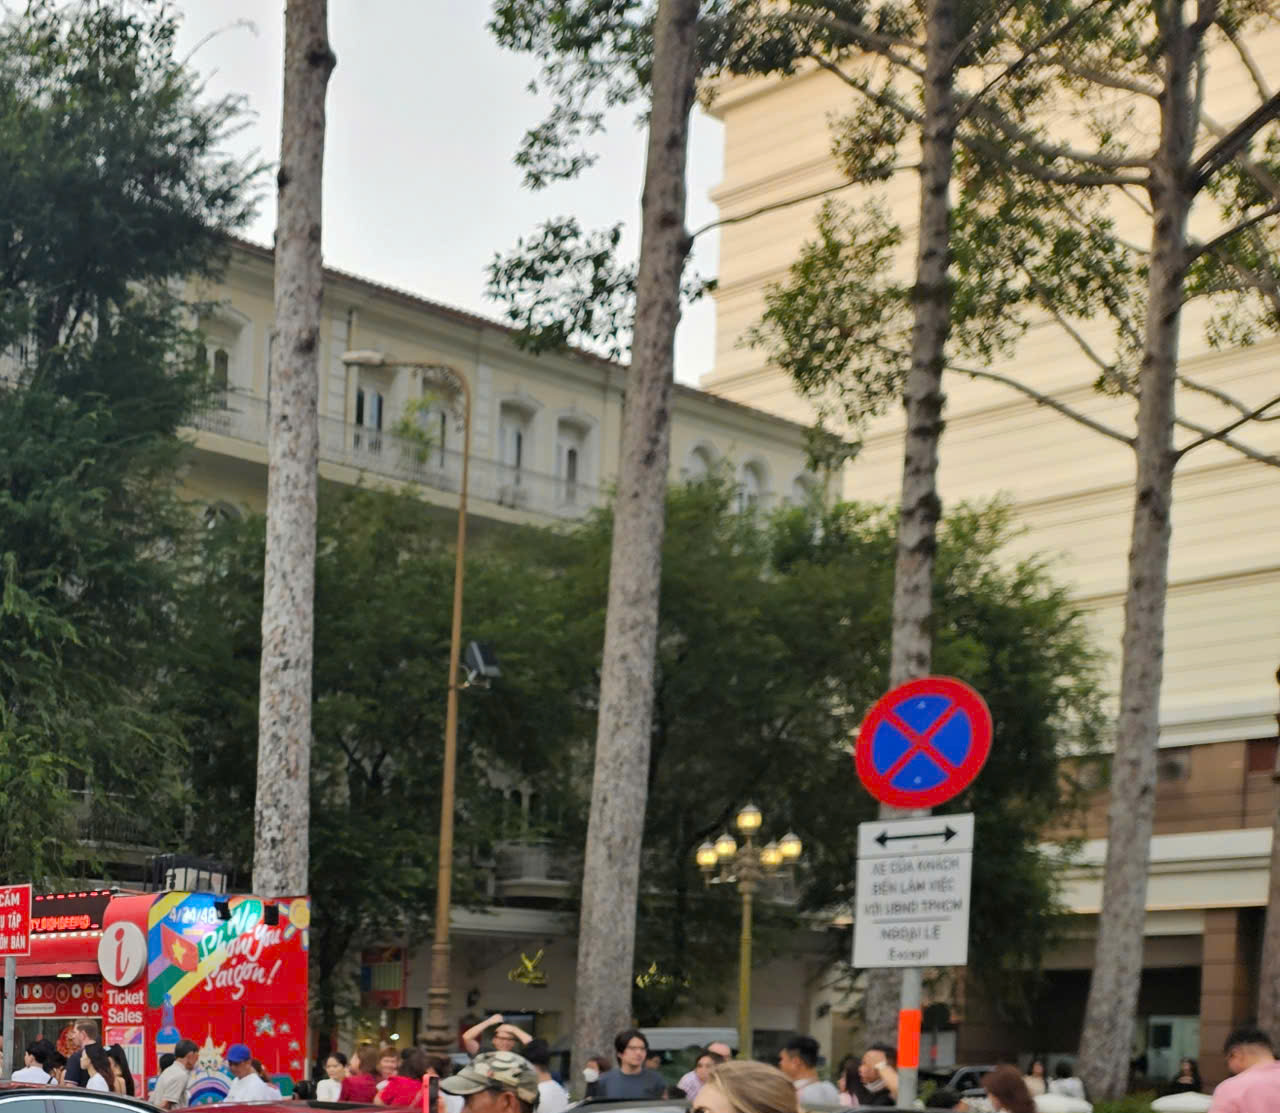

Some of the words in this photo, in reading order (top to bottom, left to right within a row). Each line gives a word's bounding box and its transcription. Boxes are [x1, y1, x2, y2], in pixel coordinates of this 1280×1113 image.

[199, 928, 254, 962] Show
[106, 988, 145, 1006] Ticket
[107, 1007, 143, 1024] Sales
